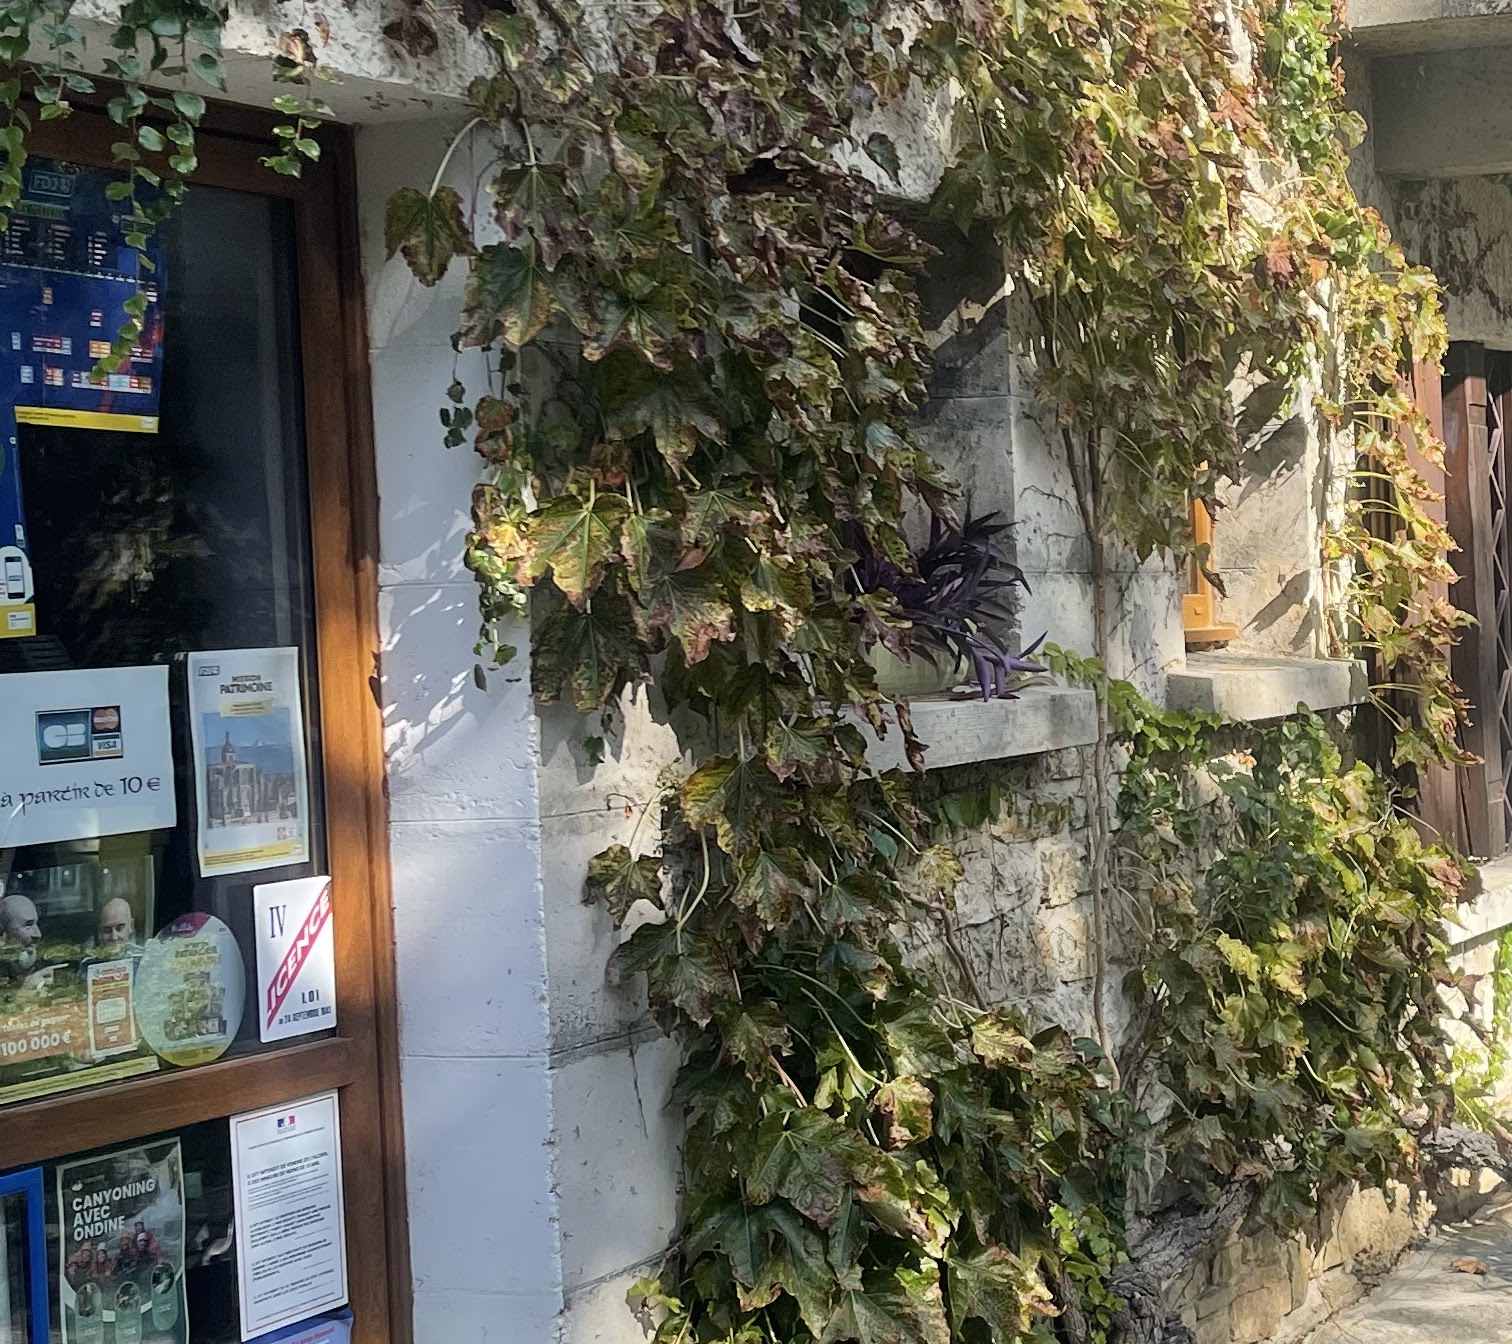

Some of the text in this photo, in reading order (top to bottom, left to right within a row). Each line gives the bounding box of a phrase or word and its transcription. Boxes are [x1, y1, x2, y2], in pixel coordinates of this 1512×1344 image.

[97, 740, 117, 750] VISA
[19, 783, 90, 816] partir
[94, 781, 114, 798] de
[119, 777, 143, 795] 10
[147, 777, 161, 791] €
[269, 905, 287, 938] IV
[267, 889, 330, 1019] ICENCE
[301, 989, 320, 1004] LOI
[1, 1038, 27, 1056] 100
[31, 1034, 60, 1050] 000
[62, 1028, 71, 1044] €
[72, 1178, 156, 1212] CANYONING
[73, 1205, 111, 1228] AVEC
[74, 1215, 126, 1242] ONDINE
